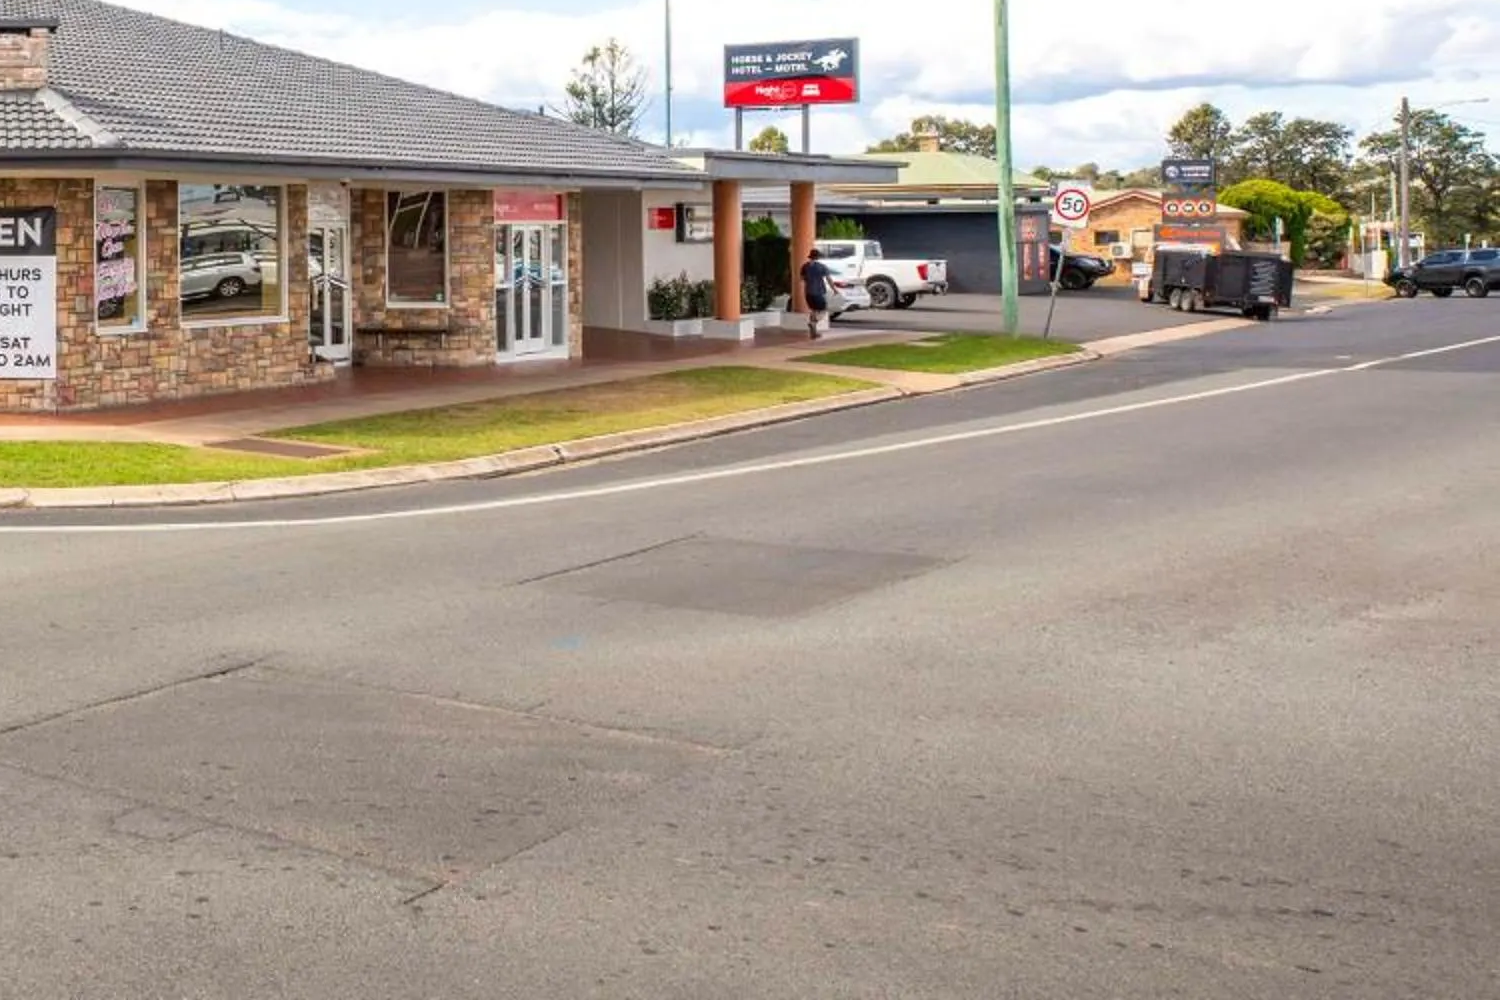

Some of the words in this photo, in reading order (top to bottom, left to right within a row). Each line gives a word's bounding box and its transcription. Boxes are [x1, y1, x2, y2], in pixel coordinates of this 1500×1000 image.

[775, 51, 814, 62] JOCKEY
[731, 65, 763, 75] HOTEL
[774, 63, 809, 73] MOTEL
[1062, 197, 1085, 213] 50
[6, 286, 30, 299] TO
[0, 337, 31, 349] SAT
[14, 353, 51, 367] 2AM
